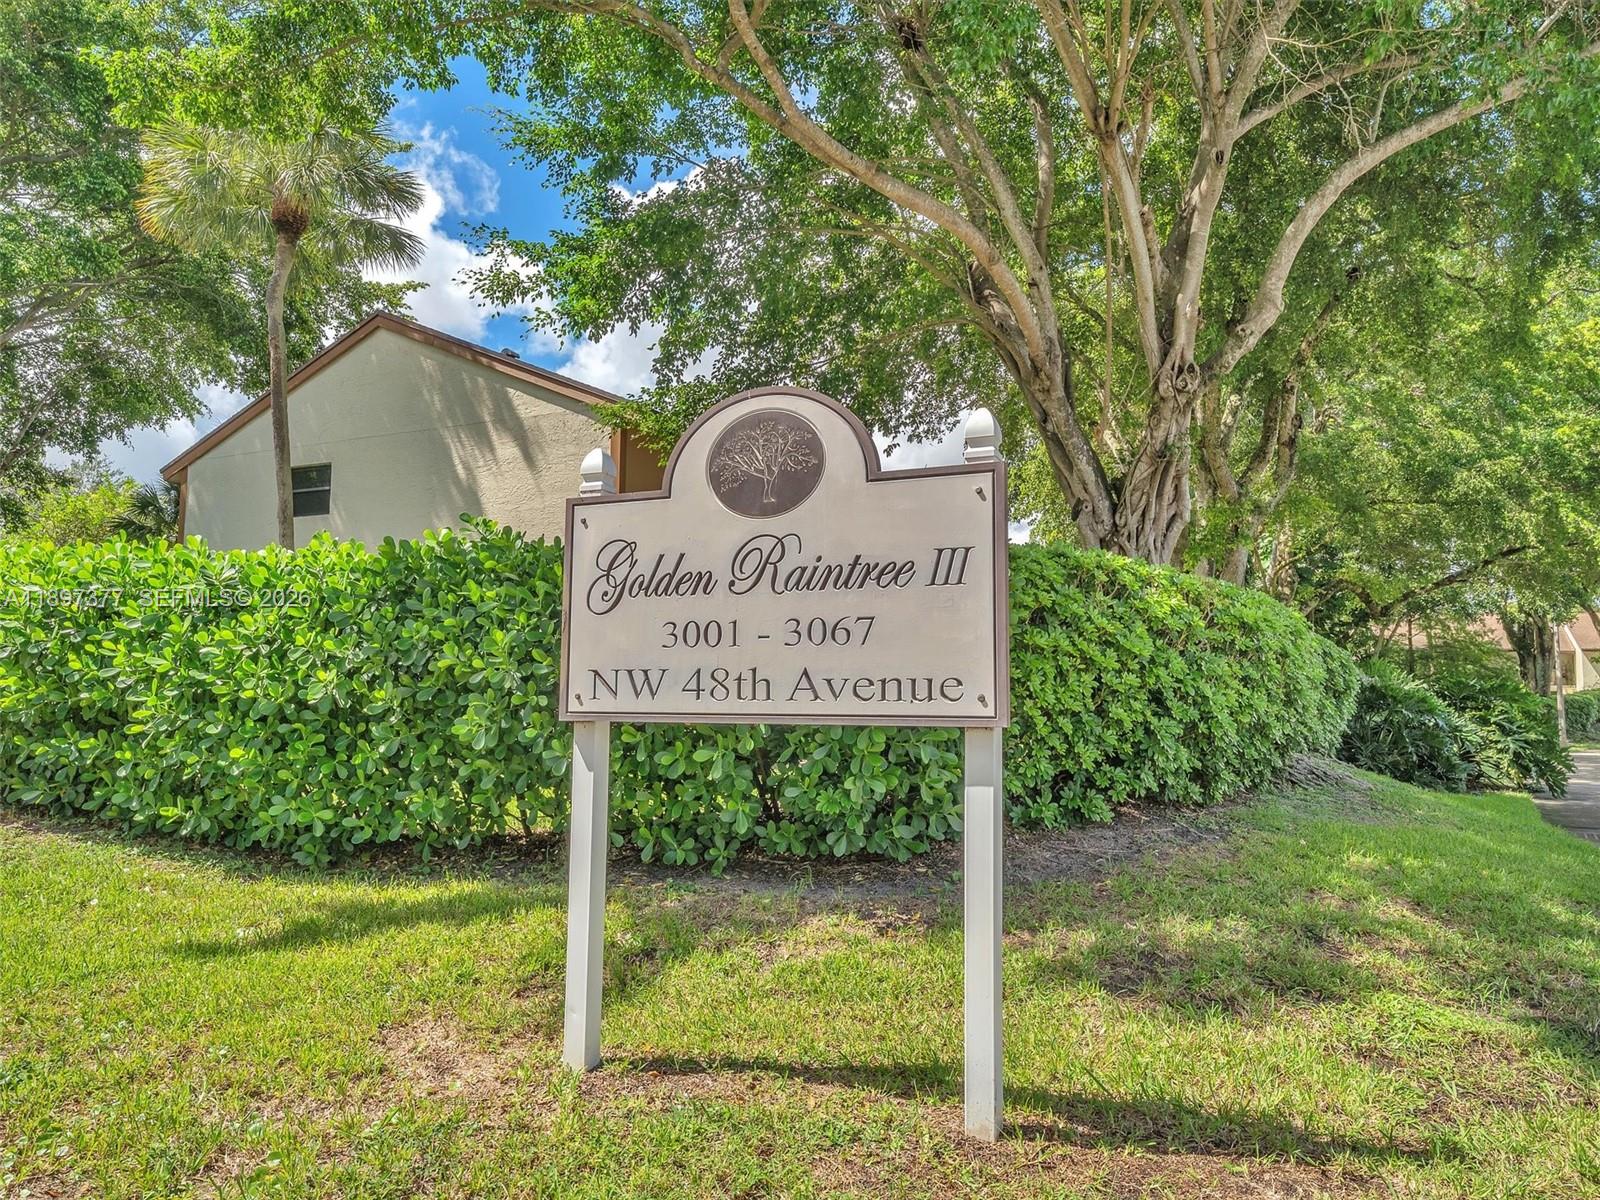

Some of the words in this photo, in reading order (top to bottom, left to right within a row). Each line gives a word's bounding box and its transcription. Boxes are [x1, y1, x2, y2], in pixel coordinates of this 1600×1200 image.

[587, 539, 718, 616] Golden
[728, 533, 916, 596] Raintree
[925, 546, 977, 587] III
[662, 619, 742, 650] 3001
[784, 615, 876, 647] 3067
[587, 668, 669, 700] NW
[682, 666, 772, 702] 48th
[788, 666, 964, 702] Avenue
